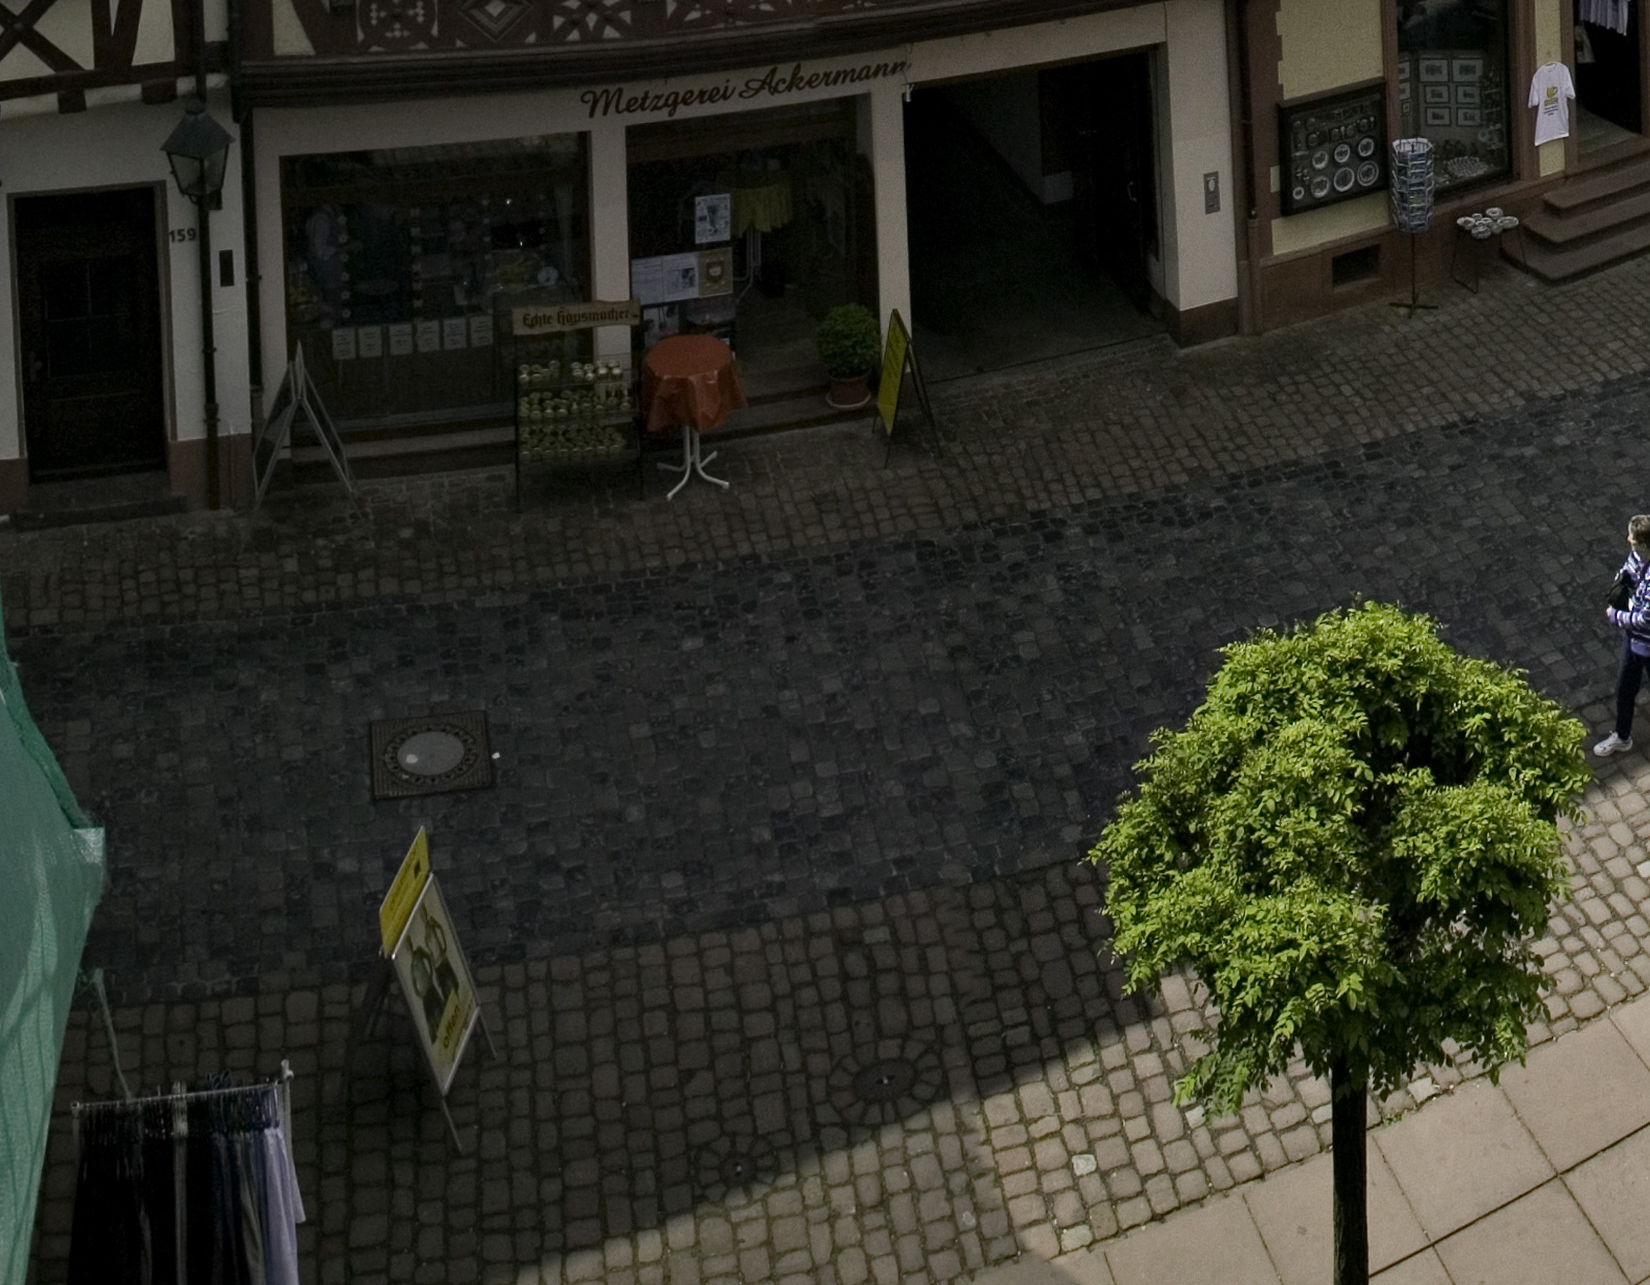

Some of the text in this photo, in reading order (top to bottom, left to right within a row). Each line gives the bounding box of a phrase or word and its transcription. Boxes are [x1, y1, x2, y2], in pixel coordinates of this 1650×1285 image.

[580, 62, 912, 118] Metzgerei Ackermann
[169, 228, 196, 243] 159
[522, 313, 553, 328] Echte
